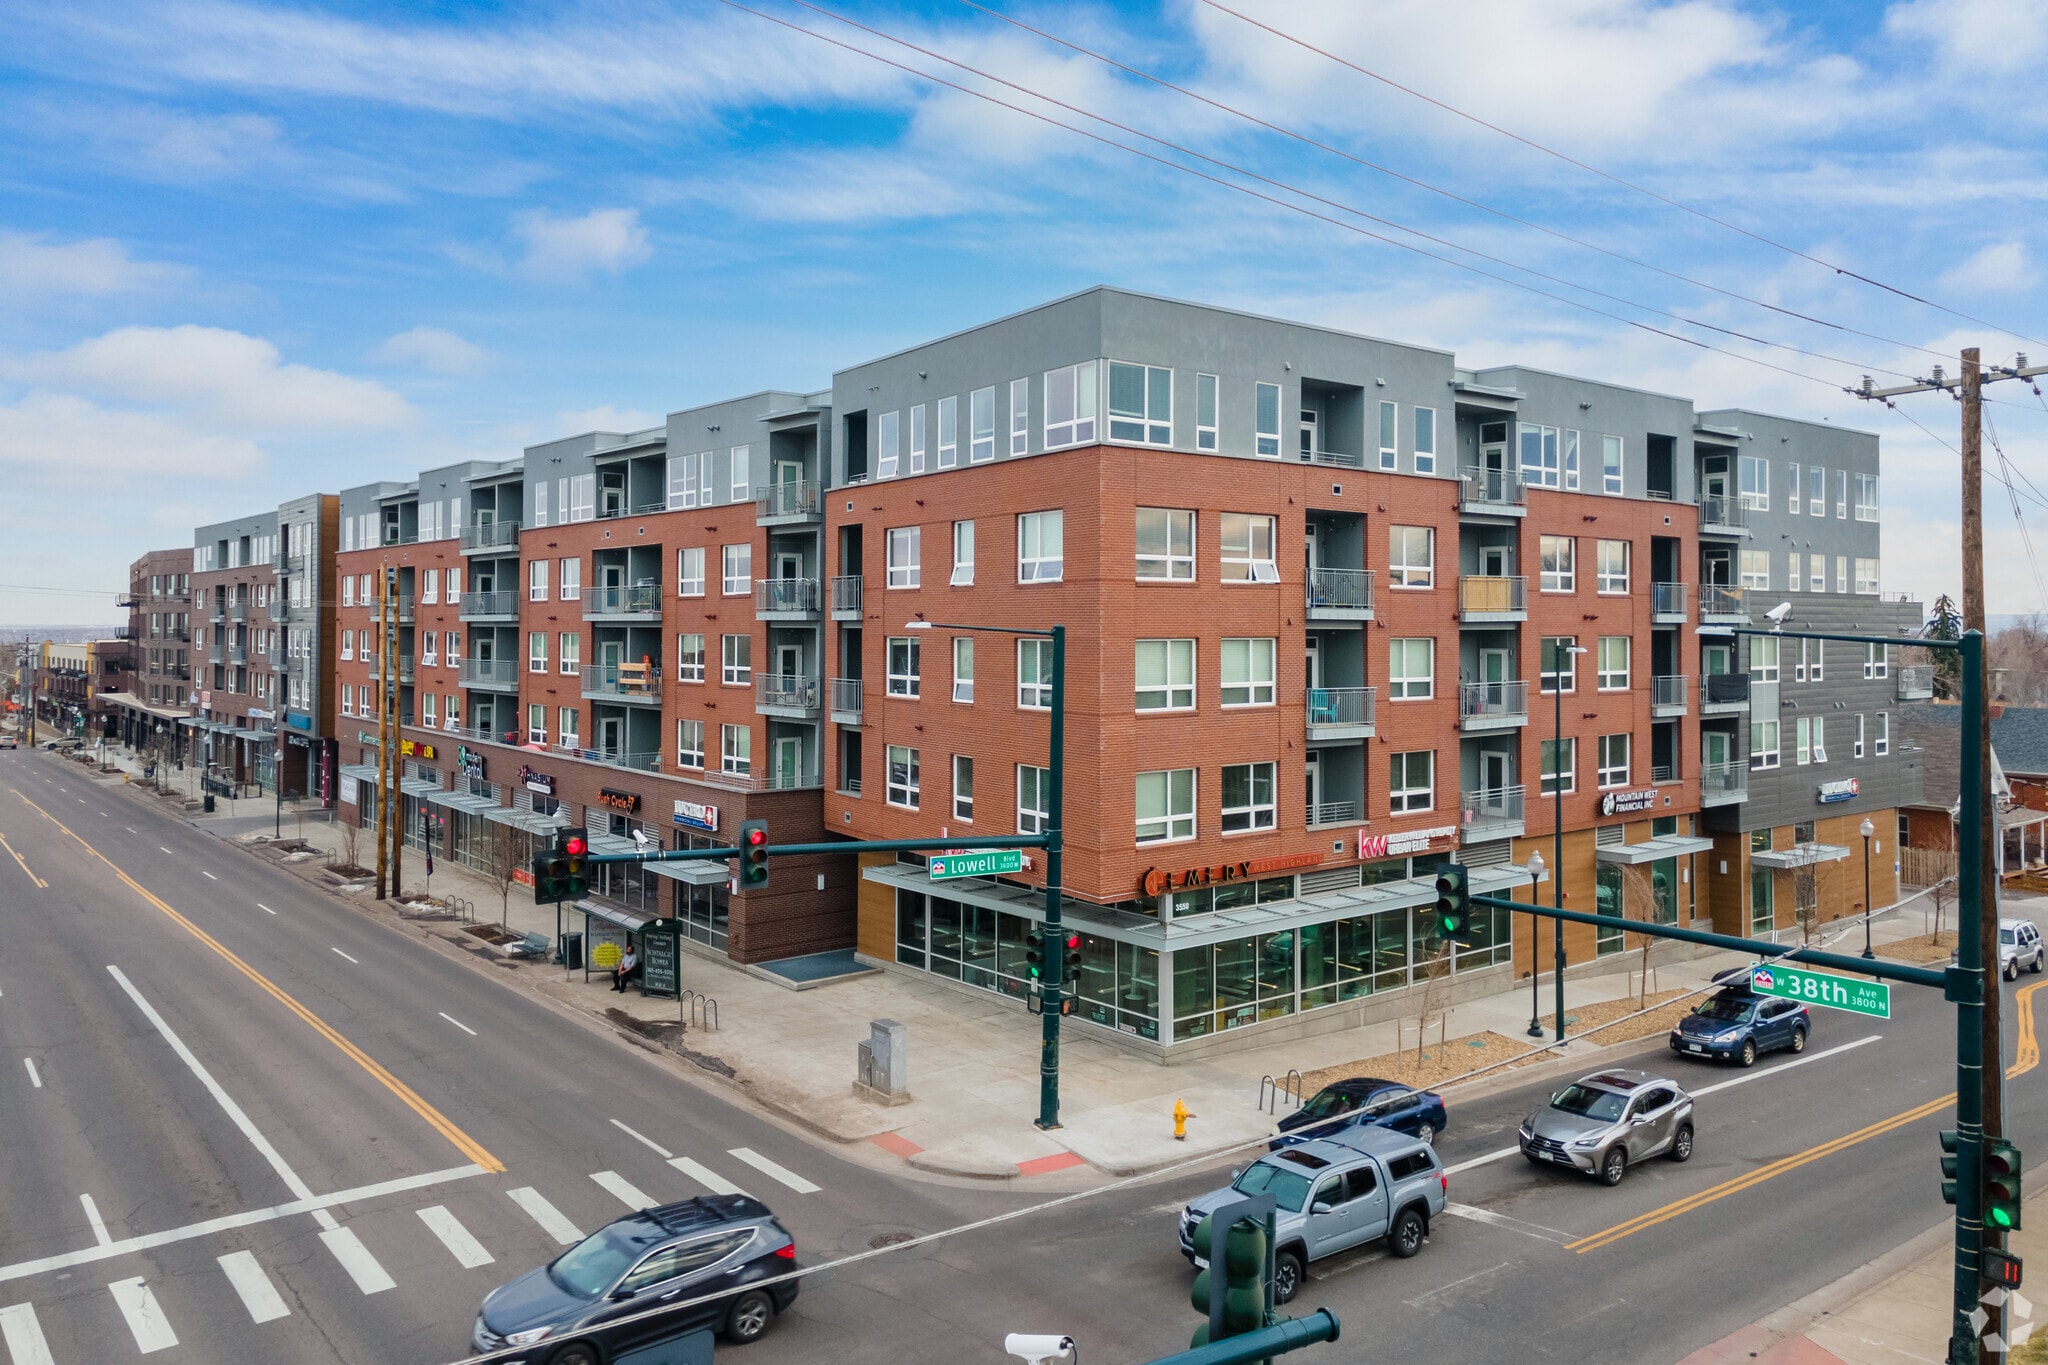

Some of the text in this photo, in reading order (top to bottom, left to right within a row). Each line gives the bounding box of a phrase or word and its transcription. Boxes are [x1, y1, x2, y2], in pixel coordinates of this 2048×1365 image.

[597, 791, 627, 809] Rush Cycle
[1616, 789, 1658, 802] MOUNTAIN WEST
[1616, 800, 1654, 812] FINANCIAL INC
[1388, 839, 1430, 855] URBAN ELITE
[951, 856, 996, 874] Lowell
[1003, 855, 1016, 863] Blvd
[1168, 854, 1324, 890] EMERY WEST HIGHLAND
[1175, 902, 1189, 911] 3550
[1776, 975, 1877, 1004] W 38th Ave
[1851, 995, 1886, 1011] 3800 N
